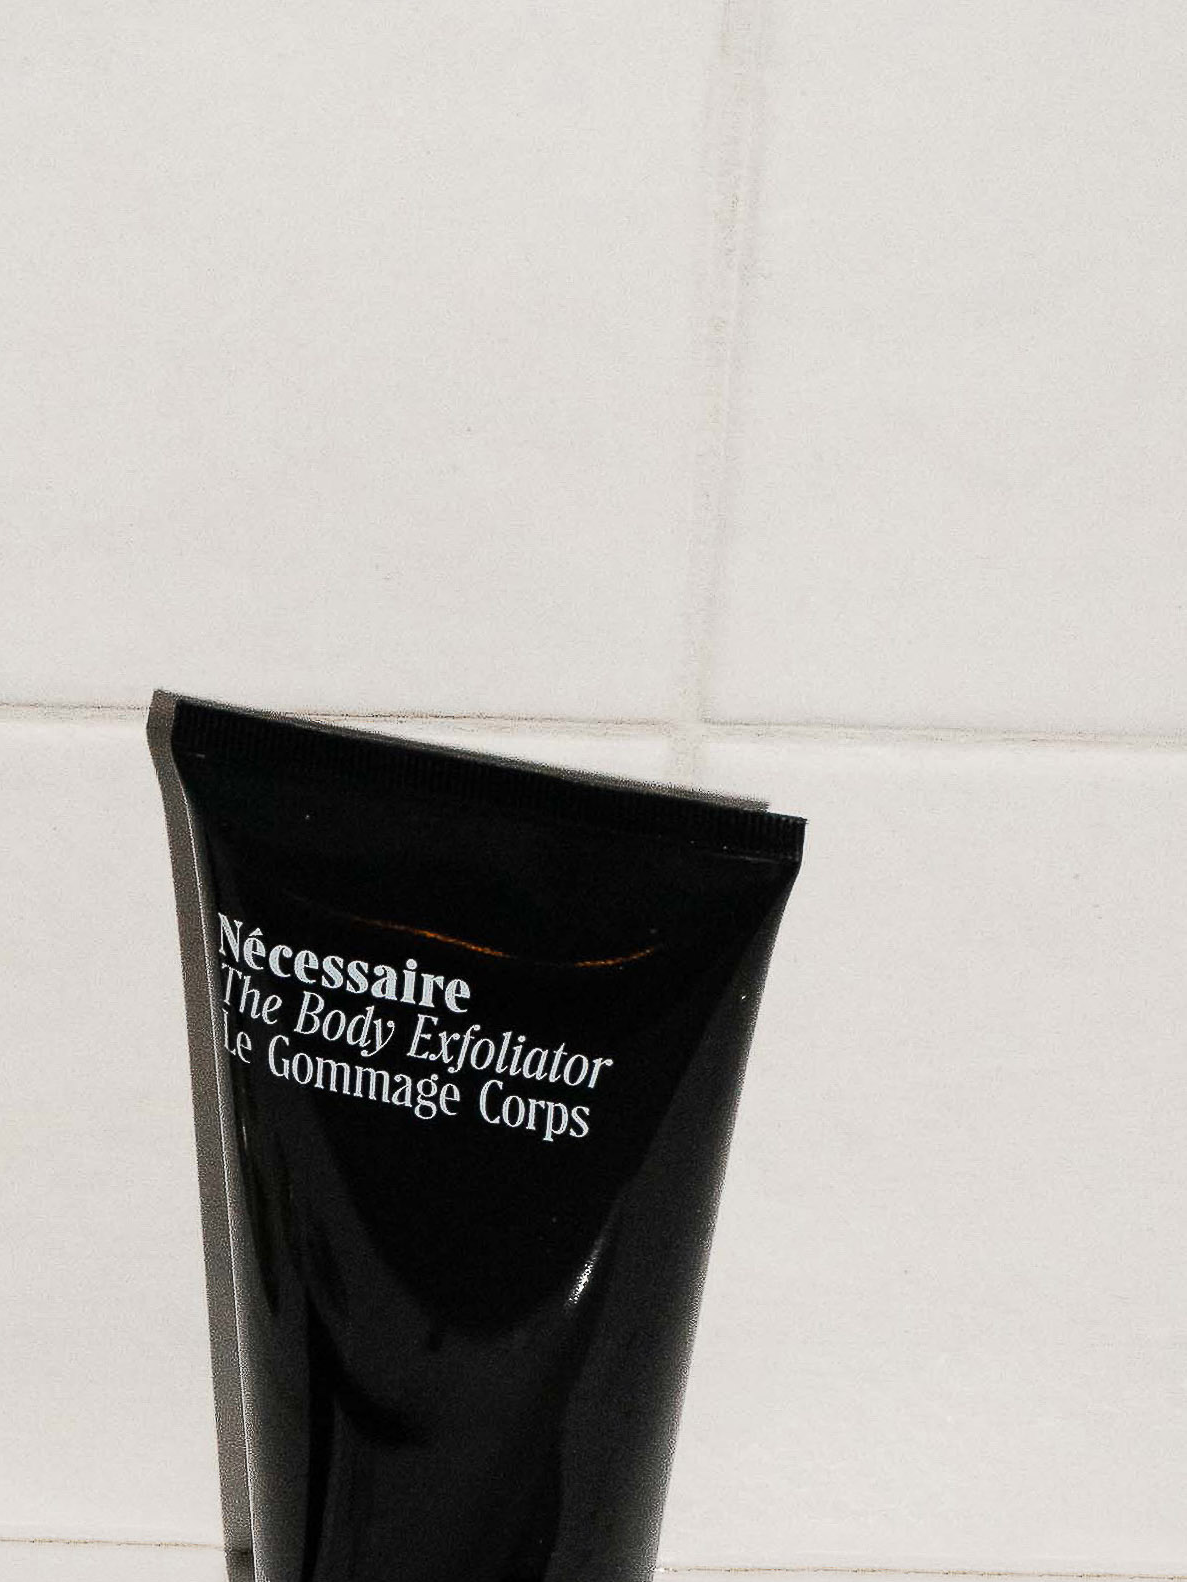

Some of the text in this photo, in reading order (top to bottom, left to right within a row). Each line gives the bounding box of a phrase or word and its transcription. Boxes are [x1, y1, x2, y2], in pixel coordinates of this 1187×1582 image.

[218, 912, 472, 1013] Nécessaire
[221, 963, 614, 1090] The Body Exfoliator
[222, 1009, 590, 1142] Le Gommage Corps
